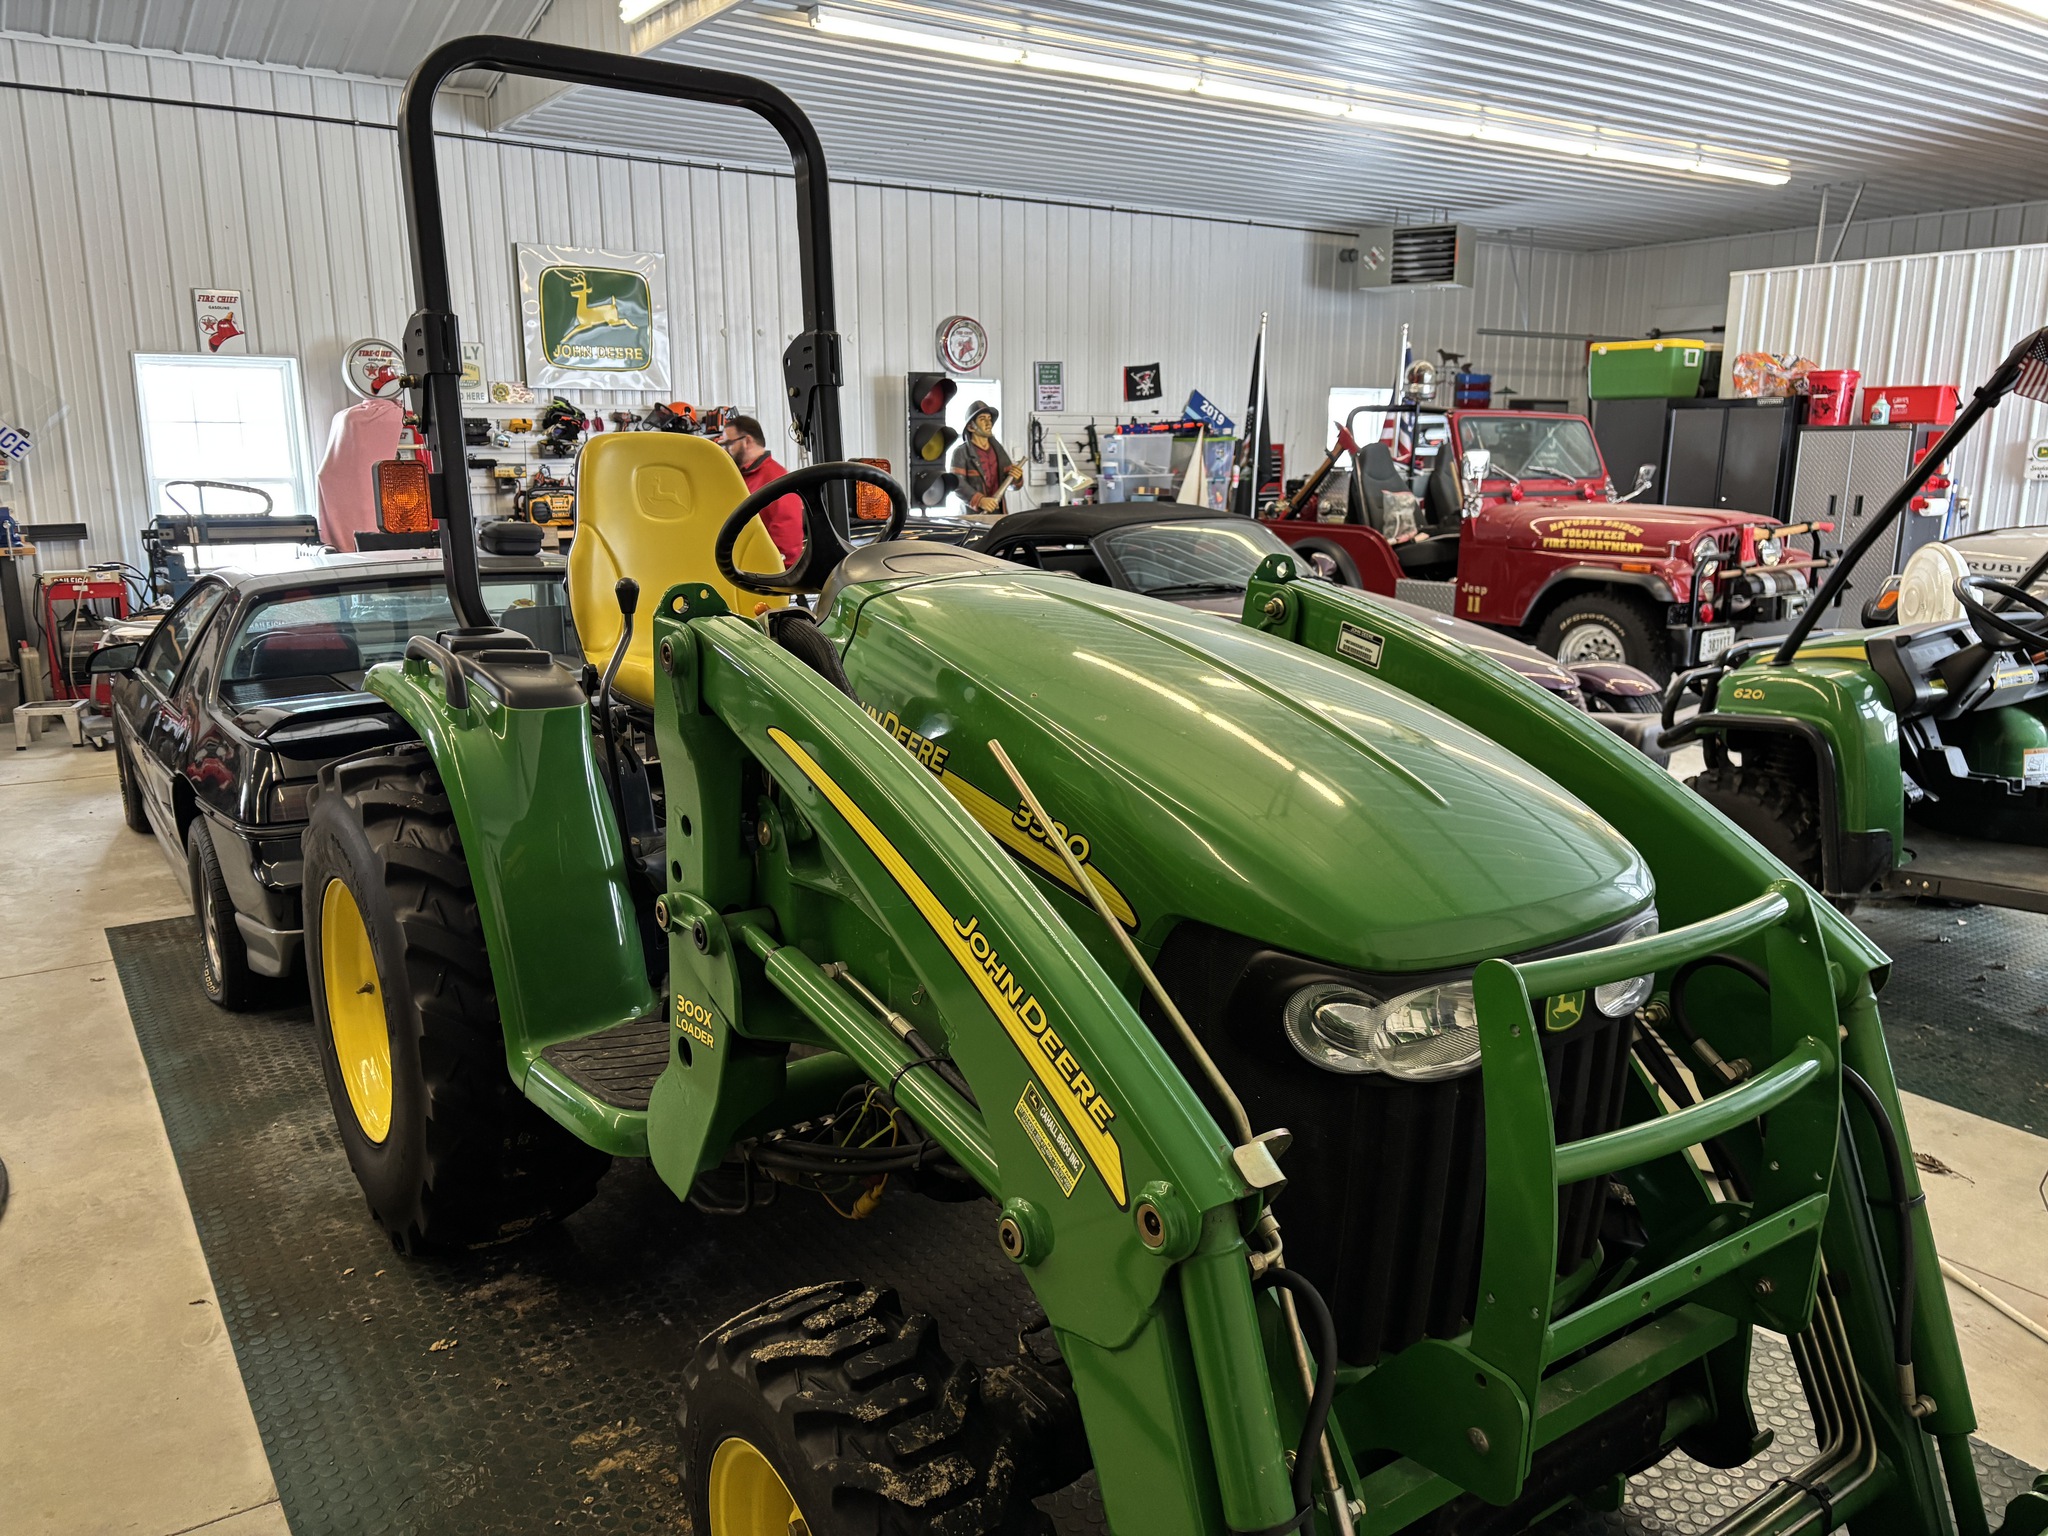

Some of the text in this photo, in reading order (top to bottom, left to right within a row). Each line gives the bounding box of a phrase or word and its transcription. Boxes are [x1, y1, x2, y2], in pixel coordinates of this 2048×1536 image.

[197, 294, 239, 304] FIRE CHIEF
[463, 345, 480, 360] LY
[553, 344, 643, 360] JOHN DEERE
[466, 392, 485, 401] HERE
[1200, 400, 1225, 426] 2019
[0, 427, 31, 458] ICE
[1549, 519, 1644, 537] NATURAL BRIDGE
[1562, 528, 1626, 541] VOLUNTEER
[1543, 537, 1644, 554] FIRE DEPARTMENT
[1967, 561, 2041, 574] RUBI
[1461, 582, 1488, 596] Jeep
[1467, 595, 1481, 613] 11
[883, 711, 949, 773] DEERE
[676, 994, 713, 1030] 300X
[675, 1014, 714, 1049] LOADER
[953, 915, 1025, 1007] JOHN
[1017, 994, 1116, 1130] DEERE
[1040, 1107, 1081, 1172] CAHALL BROS INC.
